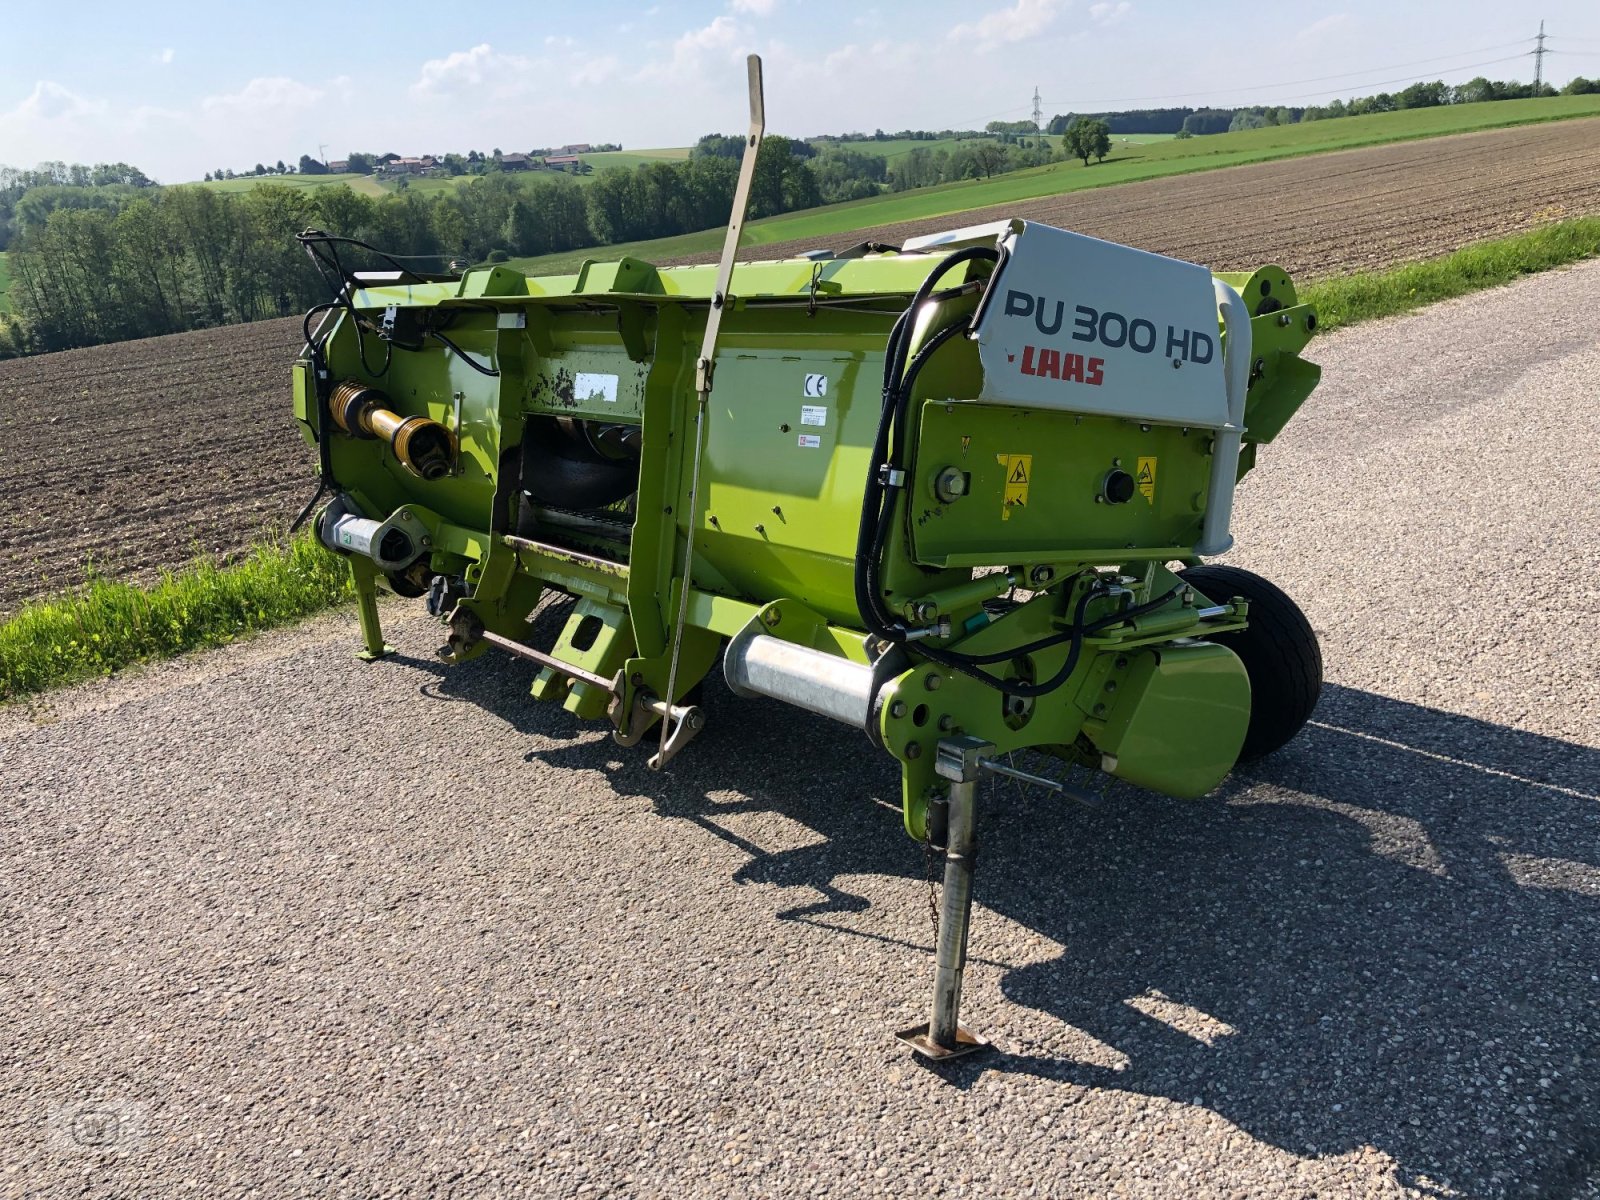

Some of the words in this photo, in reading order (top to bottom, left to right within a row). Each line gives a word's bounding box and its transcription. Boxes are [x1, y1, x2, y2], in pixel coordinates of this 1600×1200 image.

[1004, 290, 1064, 335] PU
[1072, 305, 1156, 354] 300
[1165, 326, 1214, 365] HD
[805, 375, 825, 397] CE
[1007, 345, 1104, 386] LAAS
